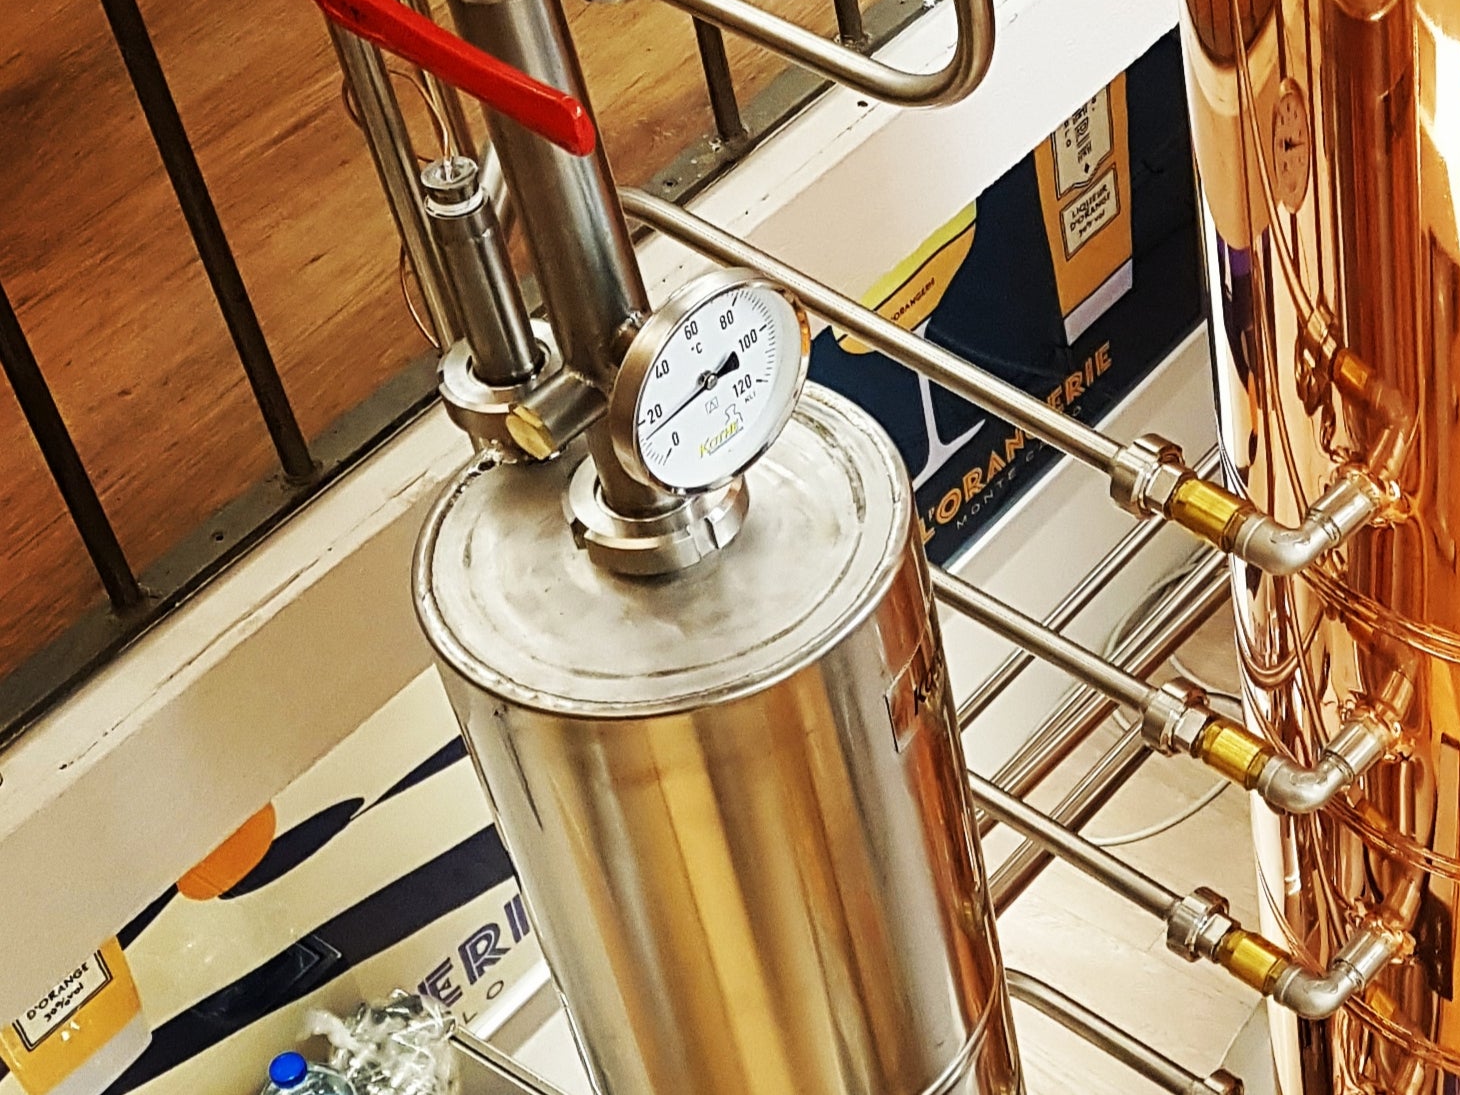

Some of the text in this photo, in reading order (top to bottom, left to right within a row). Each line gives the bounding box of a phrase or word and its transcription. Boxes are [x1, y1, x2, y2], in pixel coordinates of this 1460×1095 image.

[684, 319, 699, 341] 60
[719, 310, 735, 330] 80
[739, 328, 758, 353] 100
[655, 359, 670, 380] 40
[732, 374, 753, 398] 120
[647, 403, 663, 425] 20
[672, 431, 680, 447] 0
[919, 340, 1113, 544] L'ORANERIE
[956, 468, 1017, 530] MONTE
[26, 962, 89, 1021] D'ORANGE
